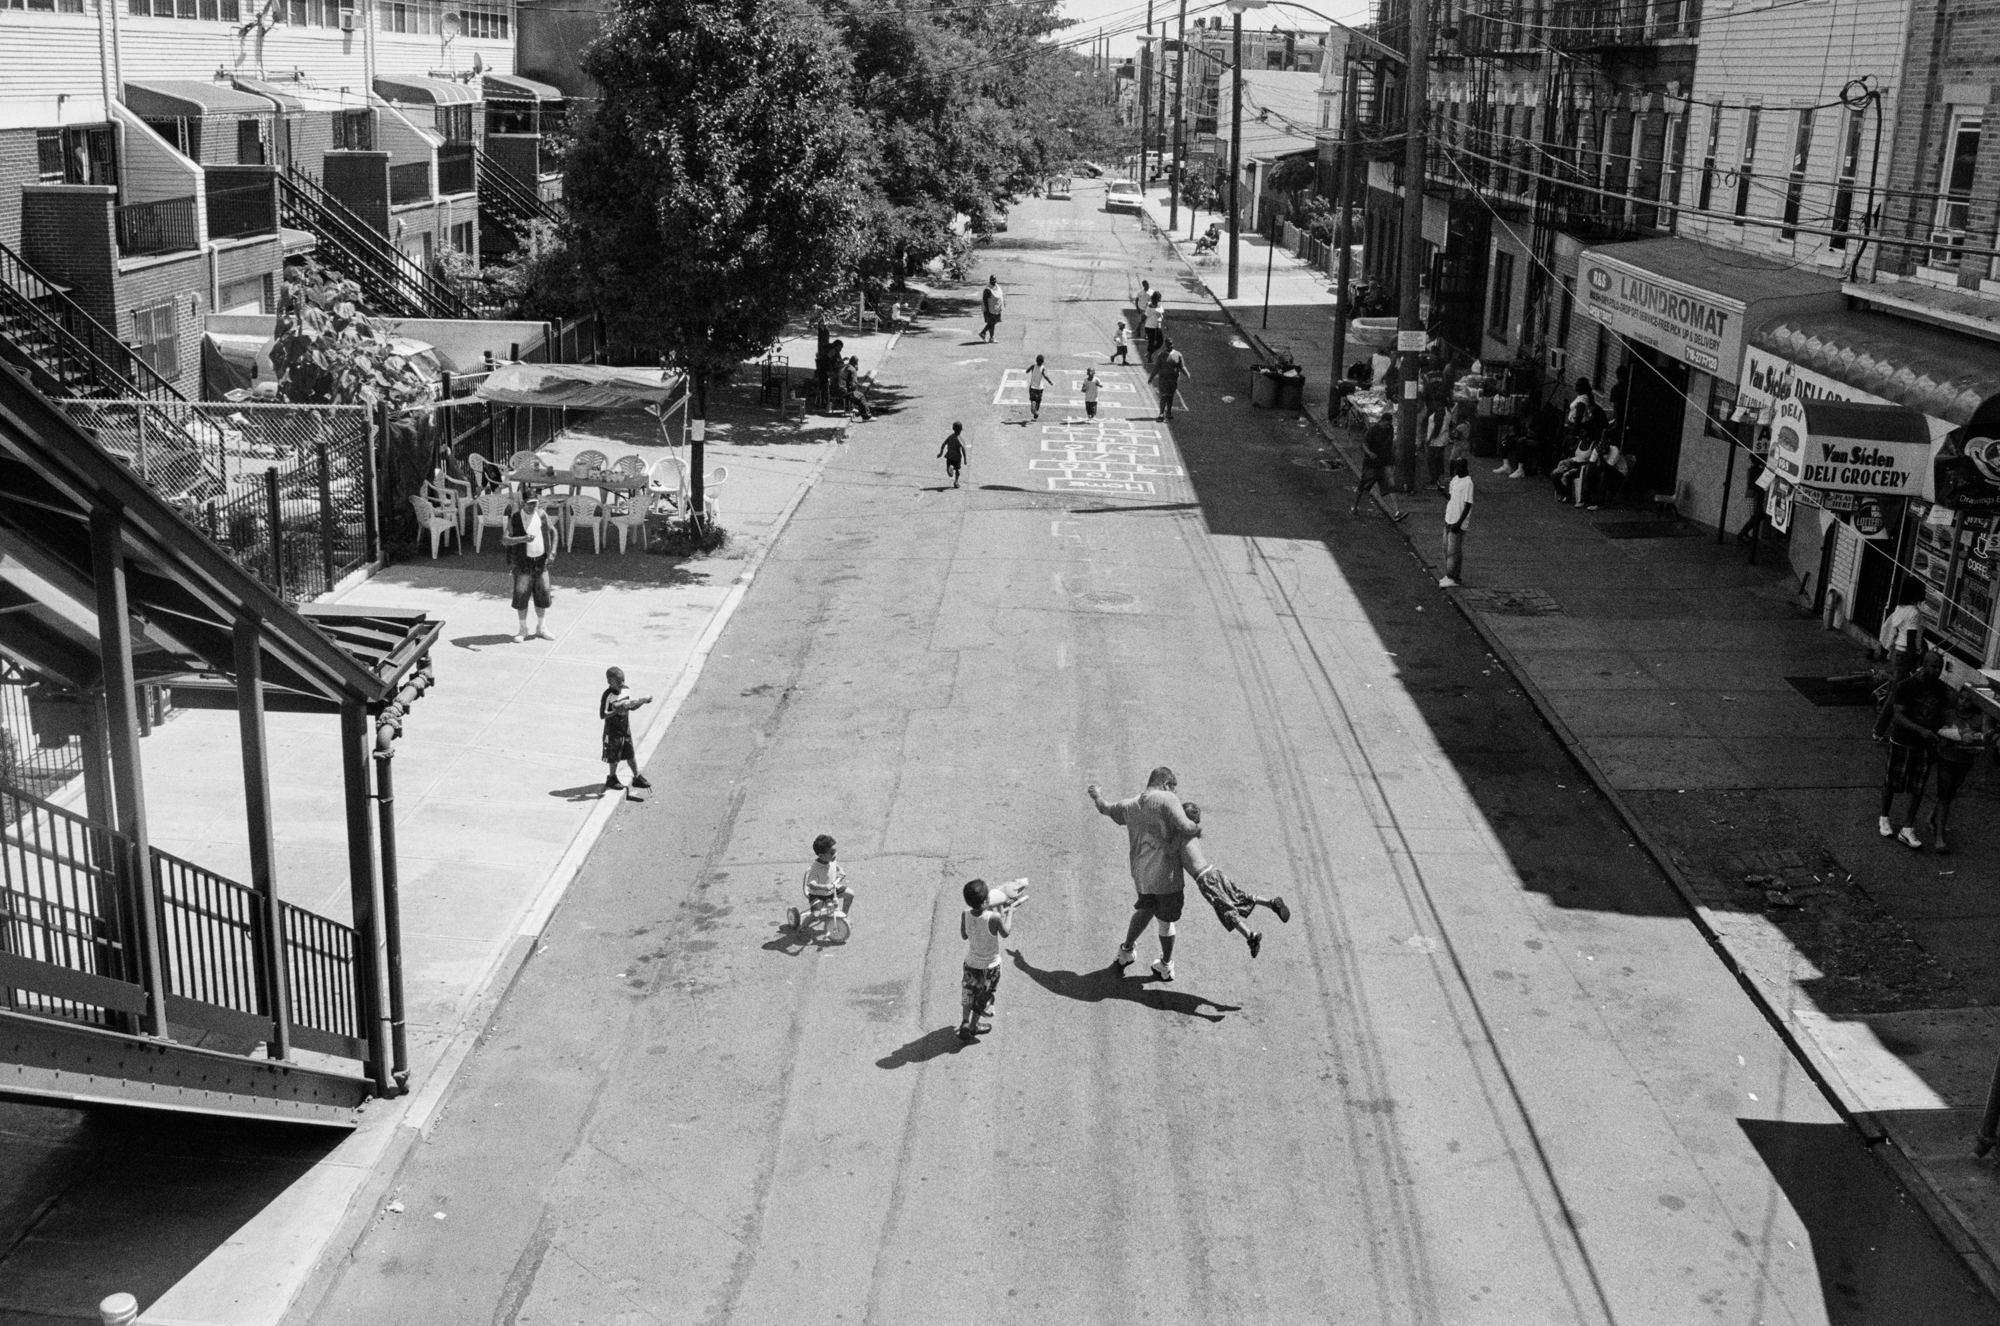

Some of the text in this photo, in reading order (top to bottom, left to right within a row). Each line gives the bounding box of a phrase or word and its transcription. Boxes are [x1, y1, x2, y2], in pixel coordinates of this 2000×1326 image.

[1593, 270, 1607, 288] R&S
[1621, 277, 1728, 337] LAUNDROMAT
[1694, 333, 1720, 352] DELIVERY
[1749, 358, 1764, 390] Van
[1764, 365, 1791, 400] Siclen
[1781, 403, 1803, 422] DELI
[1822, 443, 1894, 468] Van Siclen
[1804, 464, 1910, 488] DELI GROCERY
[1804, 489, 1820, 499] PLAY
[1835, 494, 1853, 502] PLAY
[1959, 494, 1994, 505] Drawings
[1832, 501, 1852, 509] HERE
[1856, 517, 1883, 527] LOTTERY
